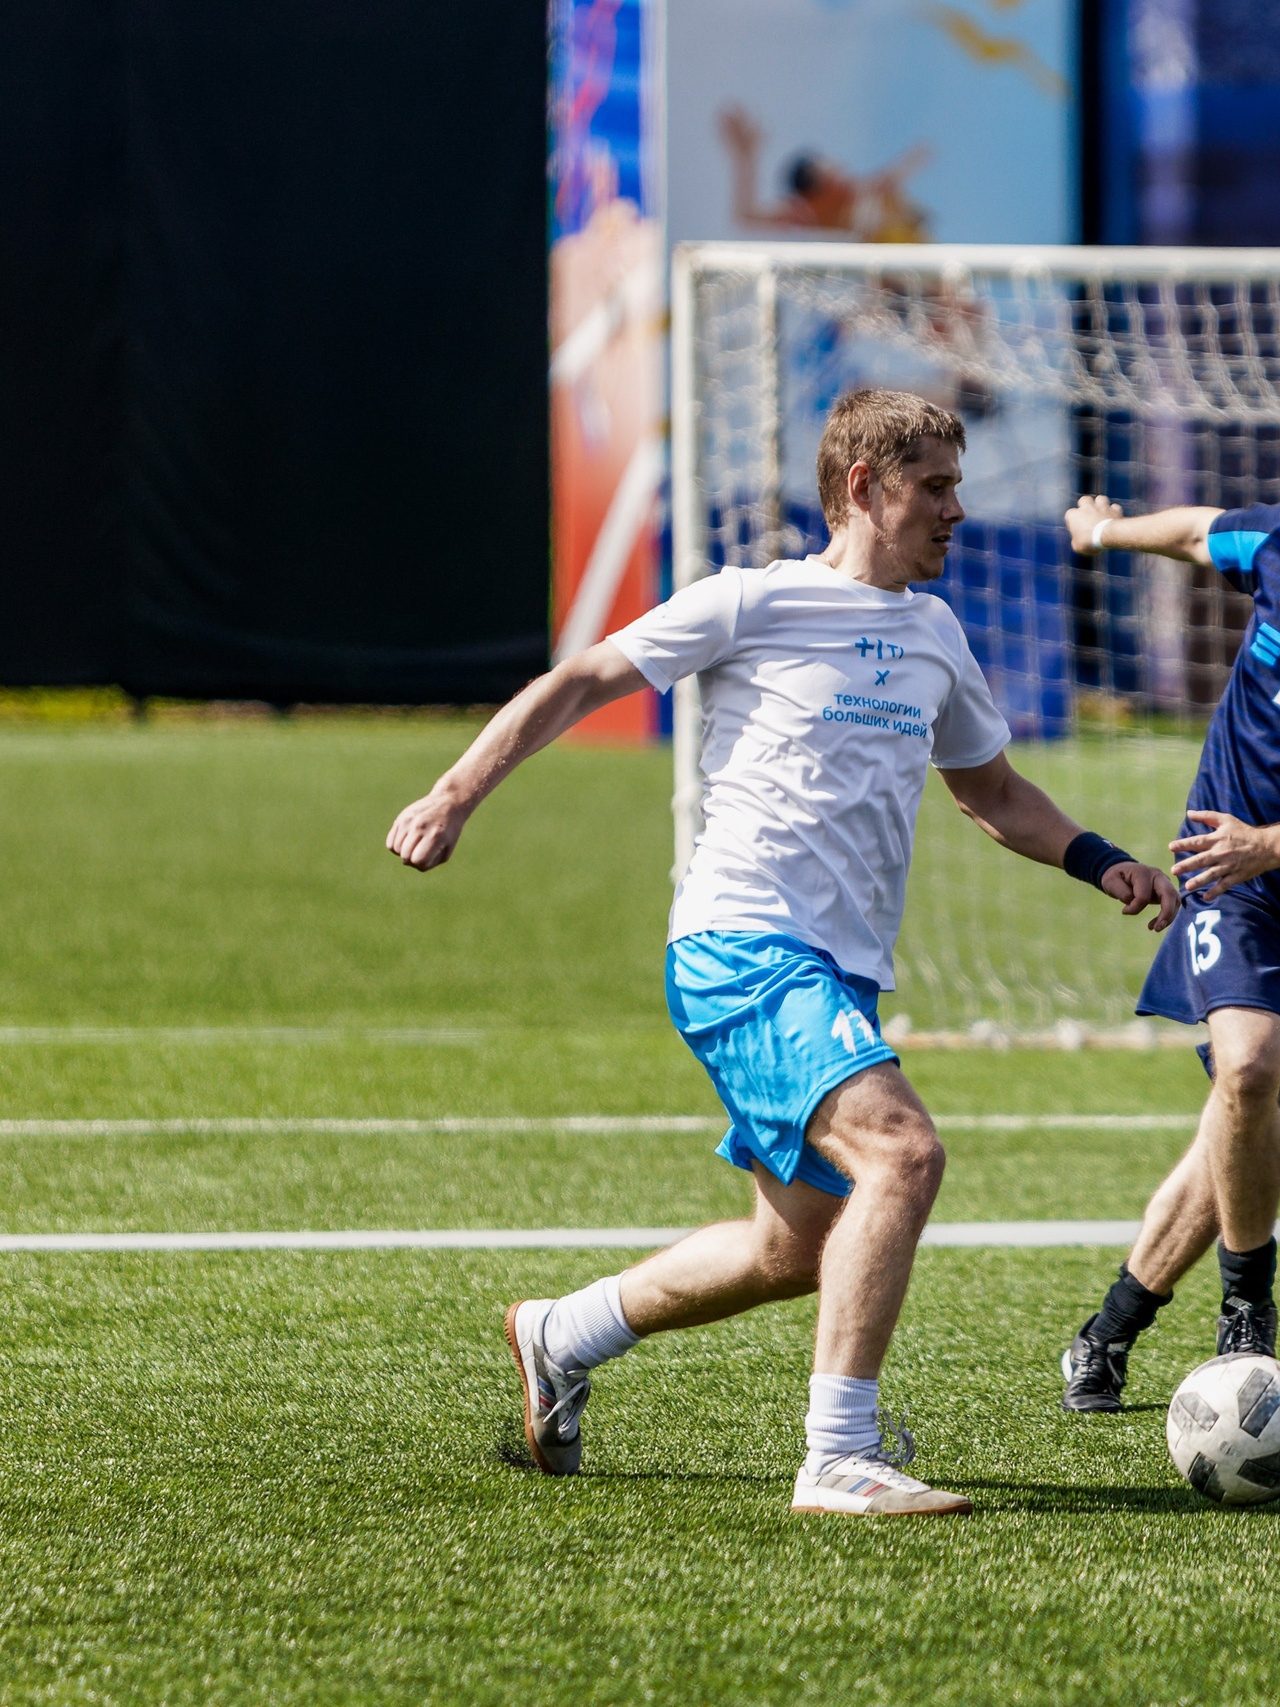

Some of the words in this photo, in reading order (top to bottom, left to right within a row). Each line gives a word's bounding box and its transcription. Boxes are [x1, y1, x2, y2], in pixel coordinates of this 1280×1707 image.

[822, 706, 890, 730] больших
[893, 721, 928, 738] идей
[833, 693, 921, 719] технологии
[1187, 909, 1222, 976] 13
